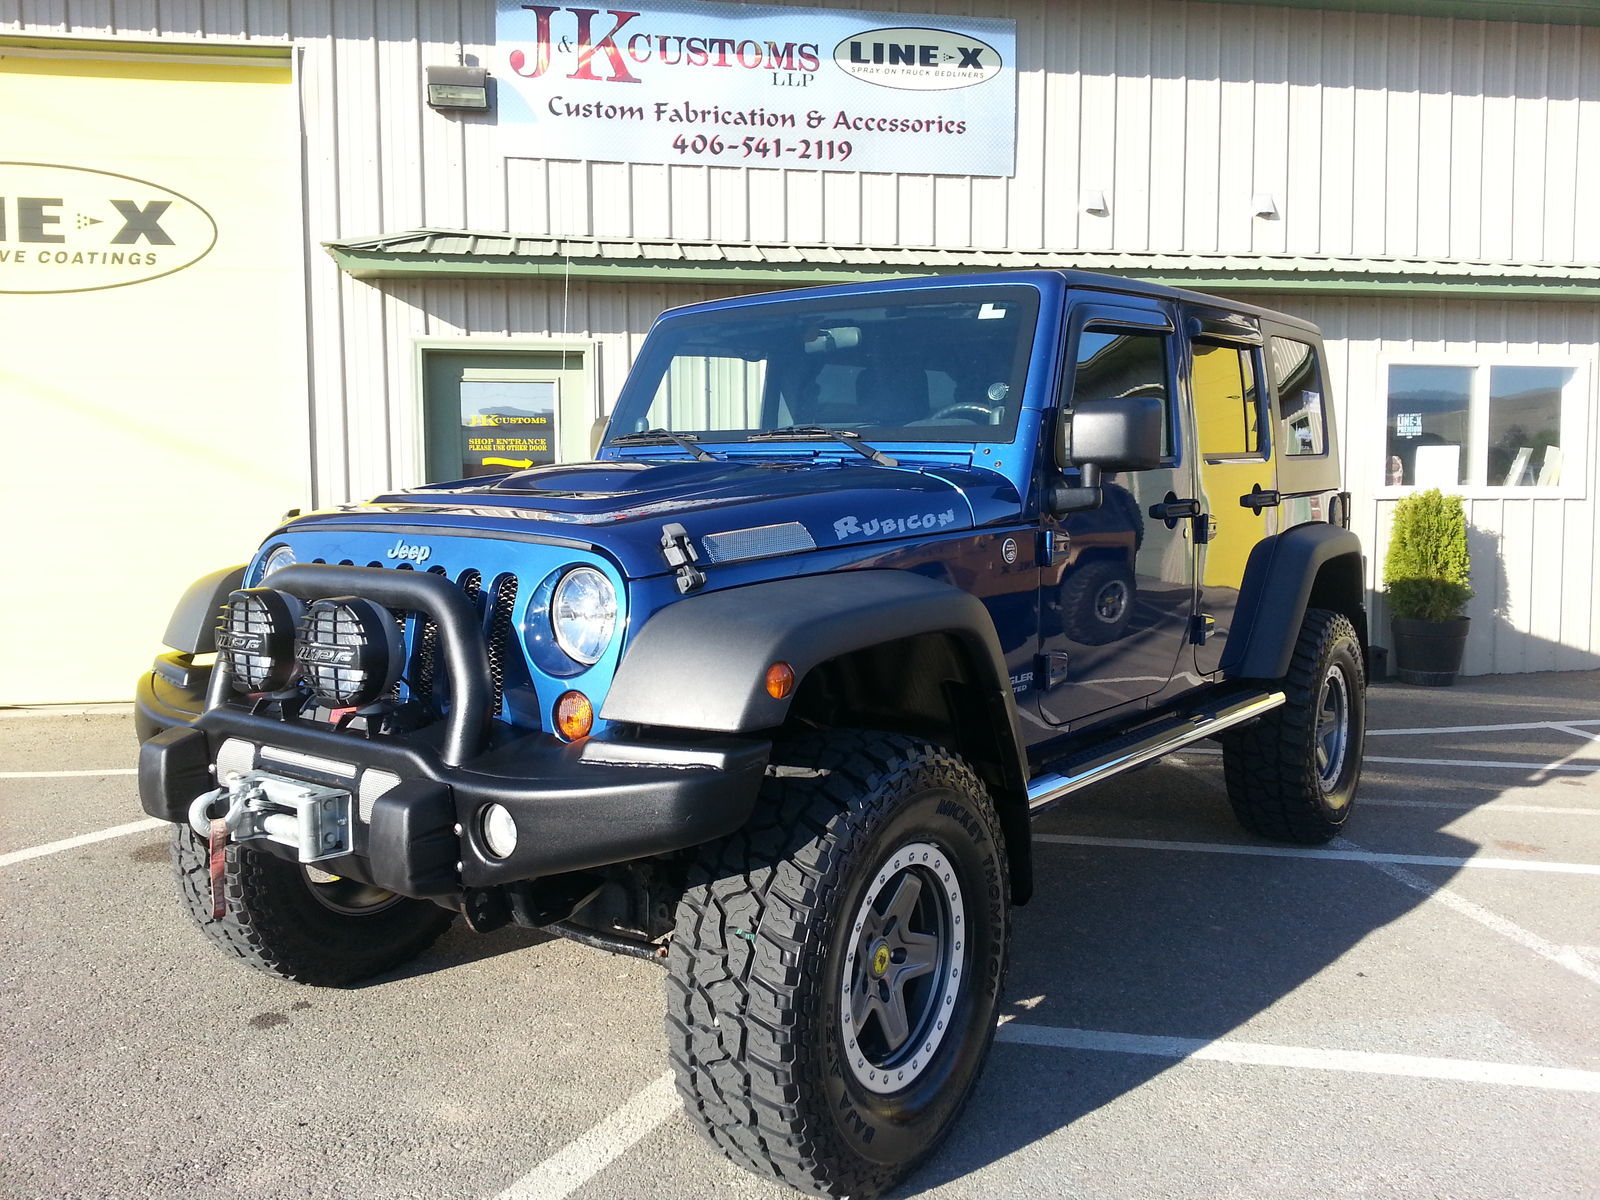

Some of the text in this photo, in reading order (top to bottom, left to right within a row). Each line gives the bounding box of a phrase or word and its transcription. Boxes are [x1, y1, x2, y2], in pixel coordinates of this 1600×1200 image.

[771, 72, 814, 87] LLP
[851, 66, 881, 74] SPRAY
[934, 71, 985, 79] BEDLINERS
[548, 96, 967, 135] Custom Fabrication & Accessories
[672, 134, 853, 162] 406-541-2119
[38, 251, 157, 265] COATINGS
[387, 539, 432, 565] Jeep
[935, 798, 1002, 998] MICKEY THOMPSON
[838, 1089, 876, 1145] BAJA
